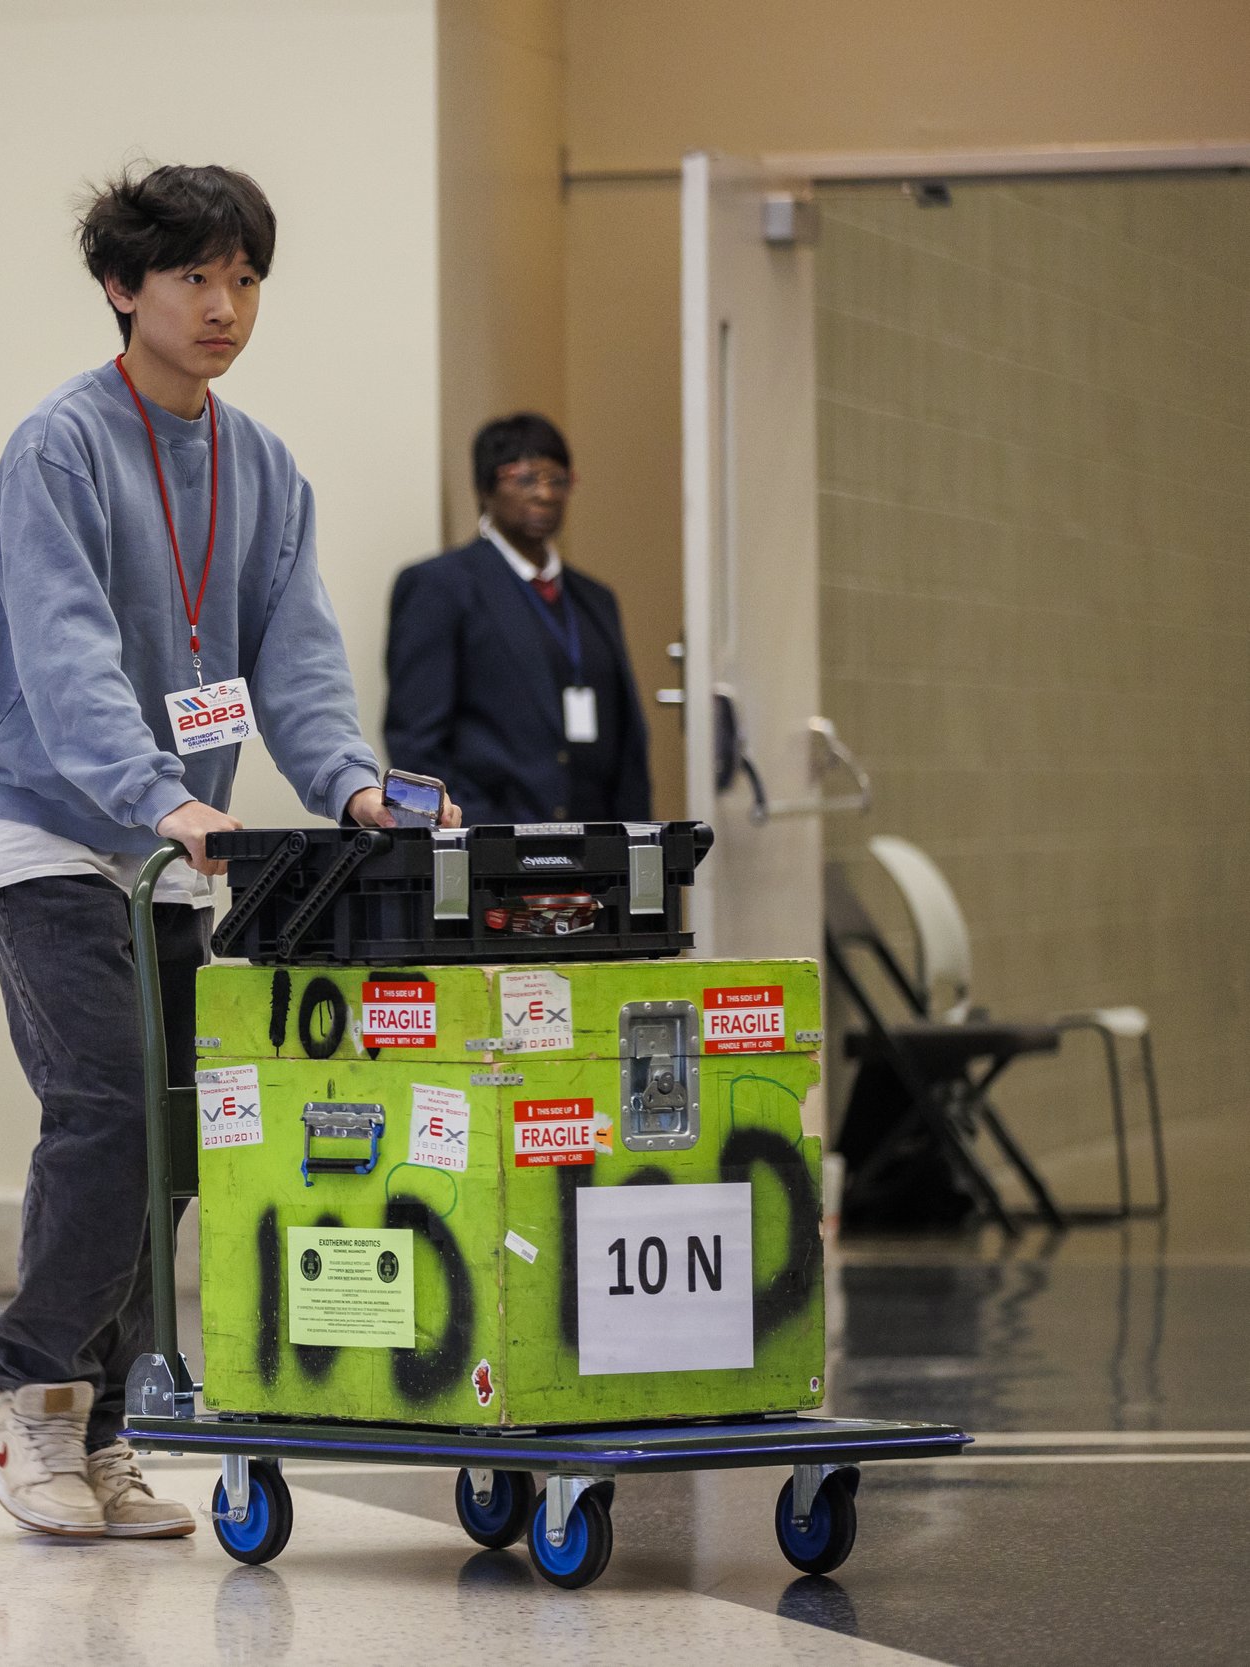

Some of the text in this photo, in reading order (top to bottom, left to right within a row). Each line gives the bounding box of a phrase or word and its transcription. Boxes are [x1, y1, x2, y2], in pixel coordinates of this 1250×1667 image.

[207, 685, 240, 699] VEX
[178, 703, 245, 731] 2023
[183, 732, 213, 743] NORTHROP
[188, 736, 219, 747] GRUMMAN
[534, 856, 568, 865] HUSKY
[726, 995, 740, 1003] THIS
[740, 994, 753, 1002] SIDE
[369, 1009, 431, 1030] FRAGILE
[504, 1000, 568, 1027] VEX
[711, 1013, 779, 1035] FRAGILE
[375, 1037, 426, 1045] HANDLE WITH CARE
[718, 1042, 740, 1050] HANDLE
[758, 1040, 773, 1048] CARE
[202, 1097, 258, 1122] VEX
[537, 1106, 573, 1115] THIS SIDE UP
[205, 1131, 260, 1145] 2010/2011
[522, 1126, 589, 1148] FRAGILE
[319, 1239, 353, 1247] EXOTHERMIC
[608, 1235, 722, 1296] 10 N
